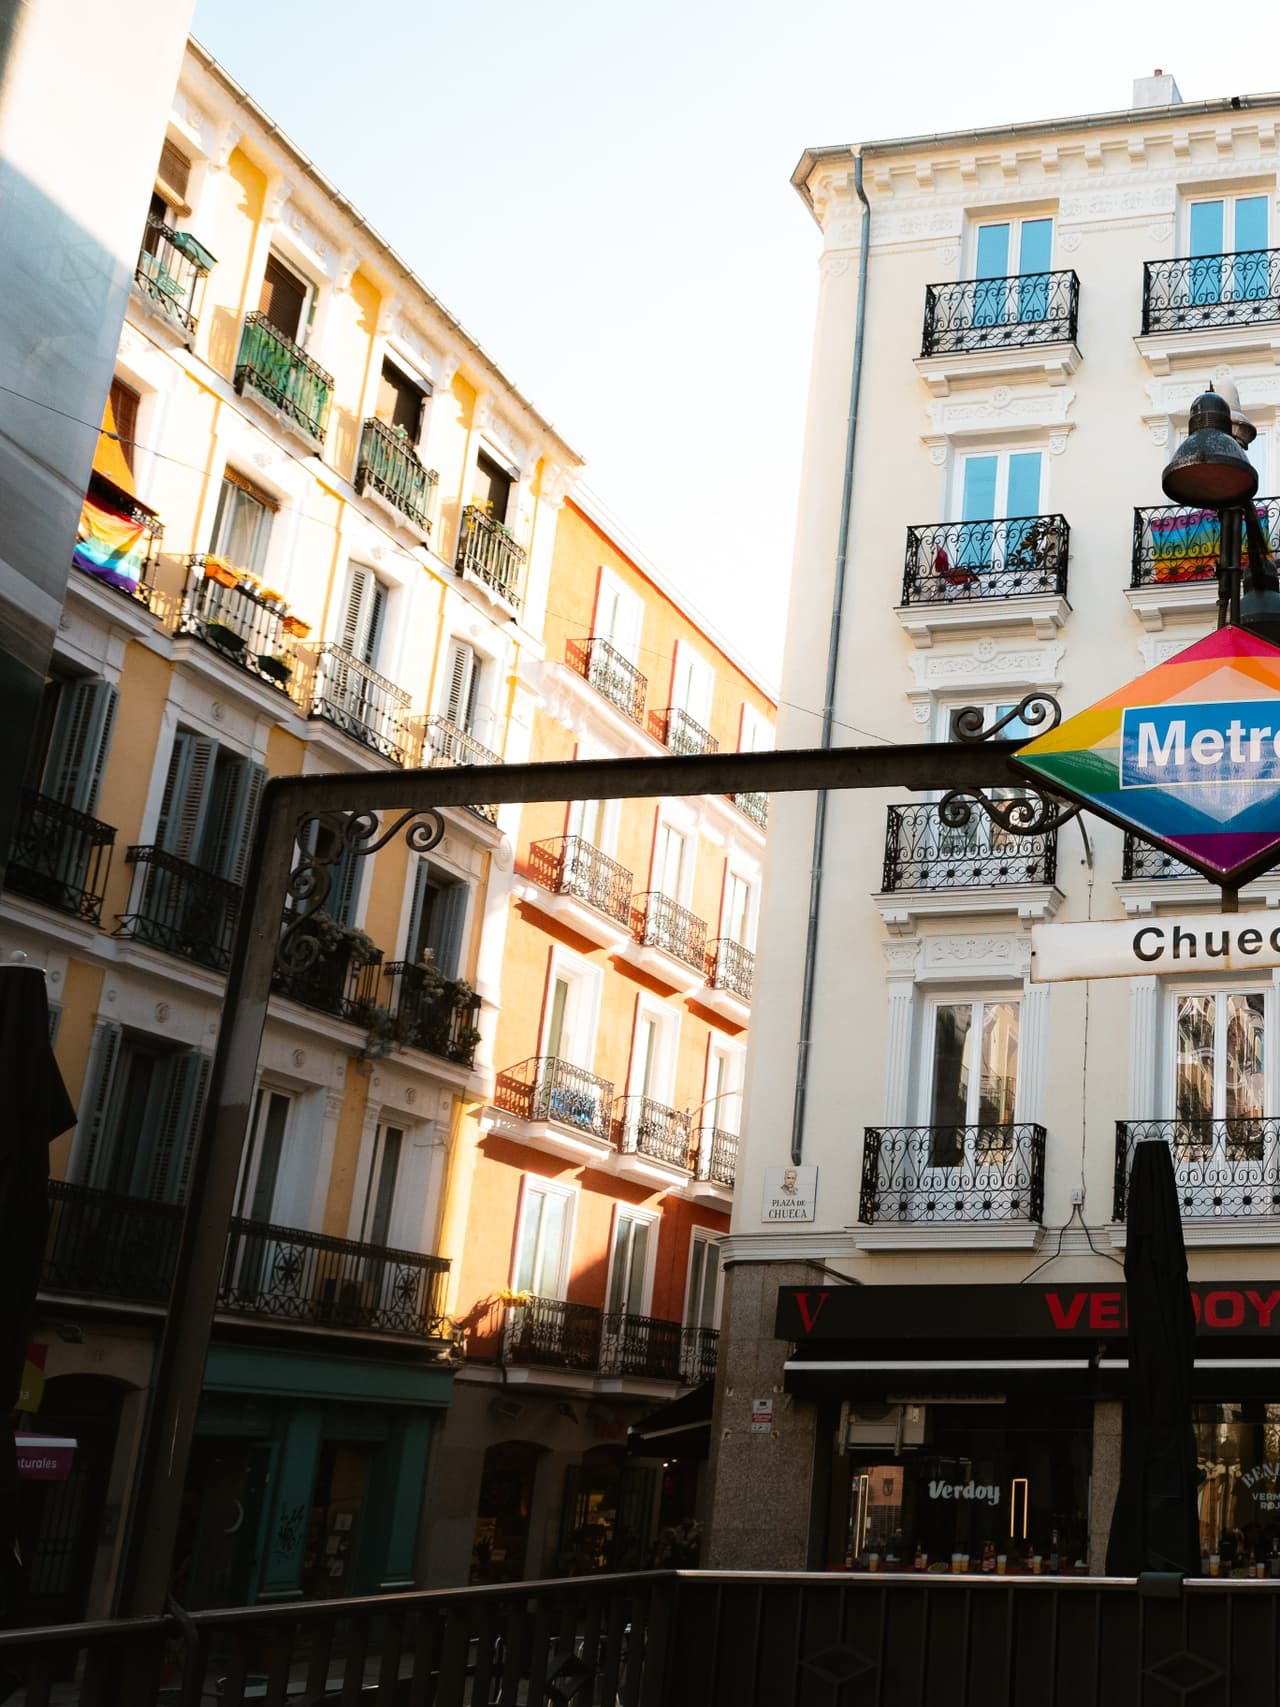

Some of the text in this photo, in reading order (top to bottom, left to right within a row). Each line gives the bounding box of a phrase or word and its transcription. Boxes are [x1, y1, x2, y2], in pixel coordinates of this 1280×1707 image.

[772, 1199, 795, 1207] PLAZA
[768, 1208, 807, 1219] CHUECA
[792, 1292, 831, 1334] V
[927, 1479, 1001, 1507] Verdoy
